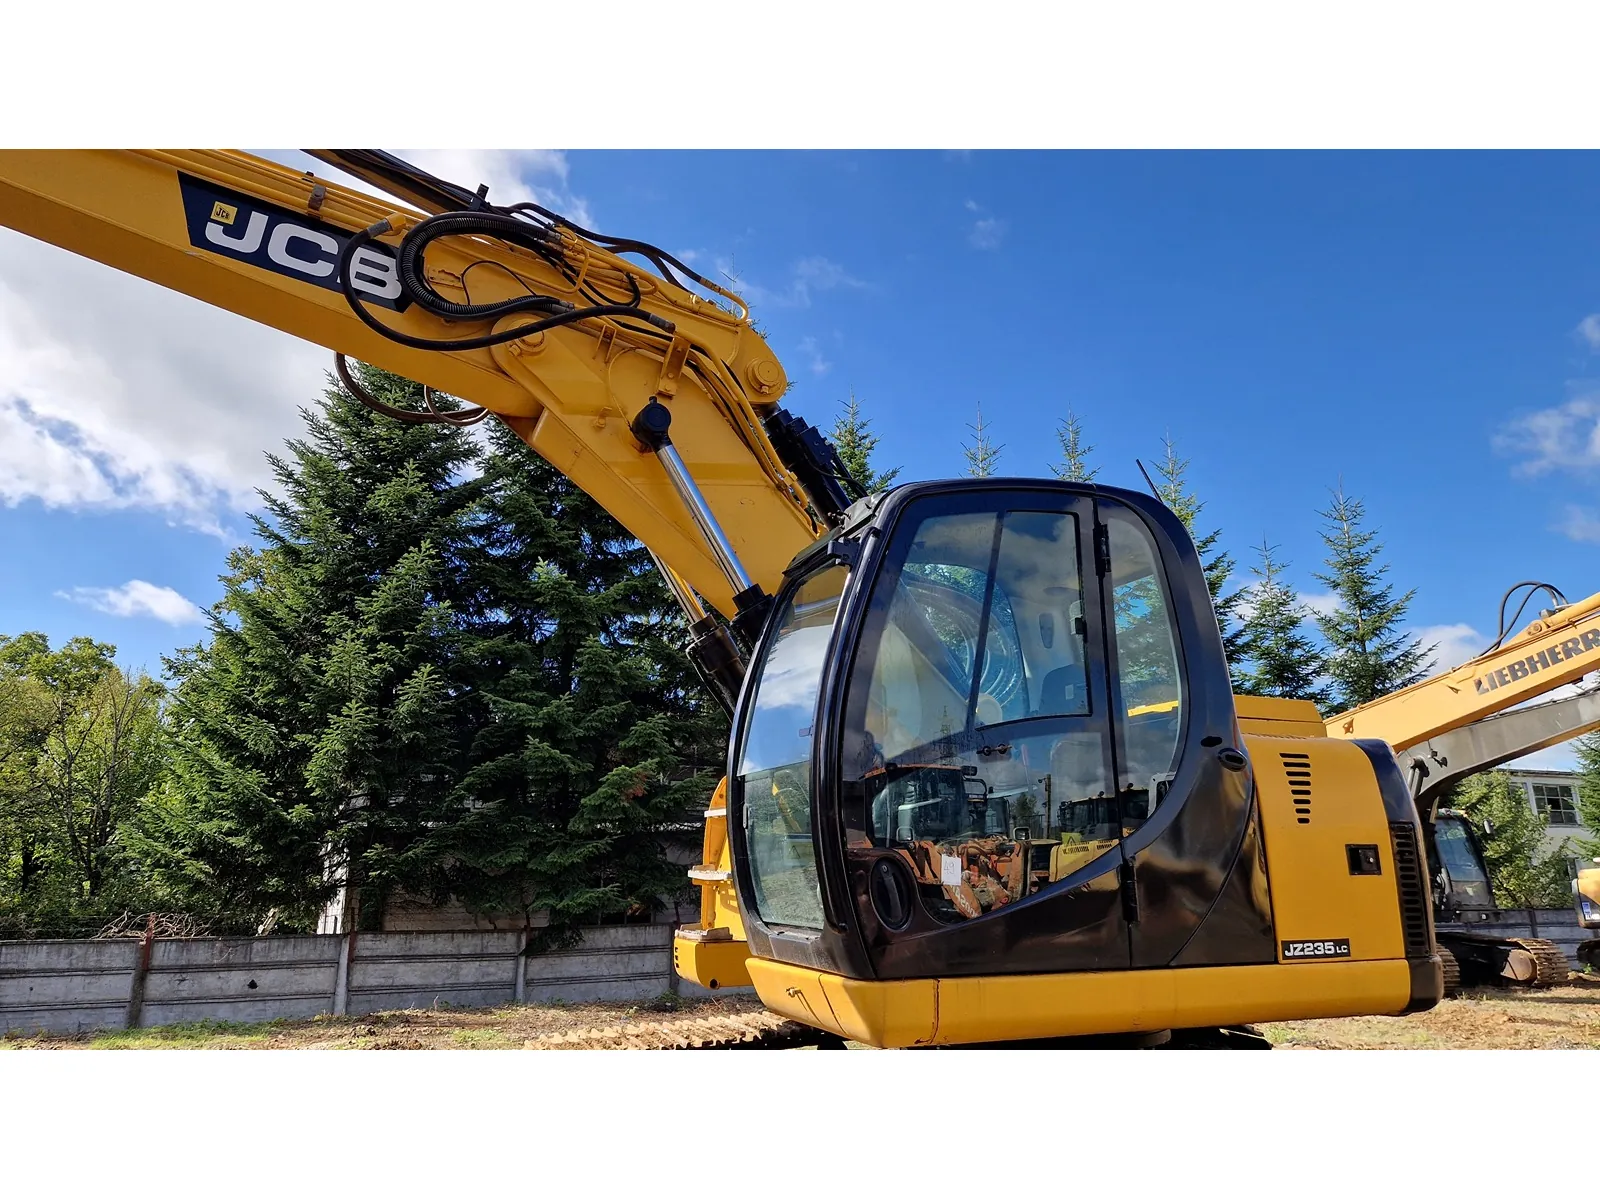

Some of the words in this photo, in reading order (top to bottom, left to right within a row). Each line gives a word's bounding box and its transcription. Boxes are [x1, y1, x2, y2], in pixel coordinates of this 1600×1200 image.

[205, 211, 402, 300] JCB
[1474, 628, 1600, 695] LIEBHERR
[1285, 942, 1334, 956] JZ235
[1336, 945, 1348, 953] LC
